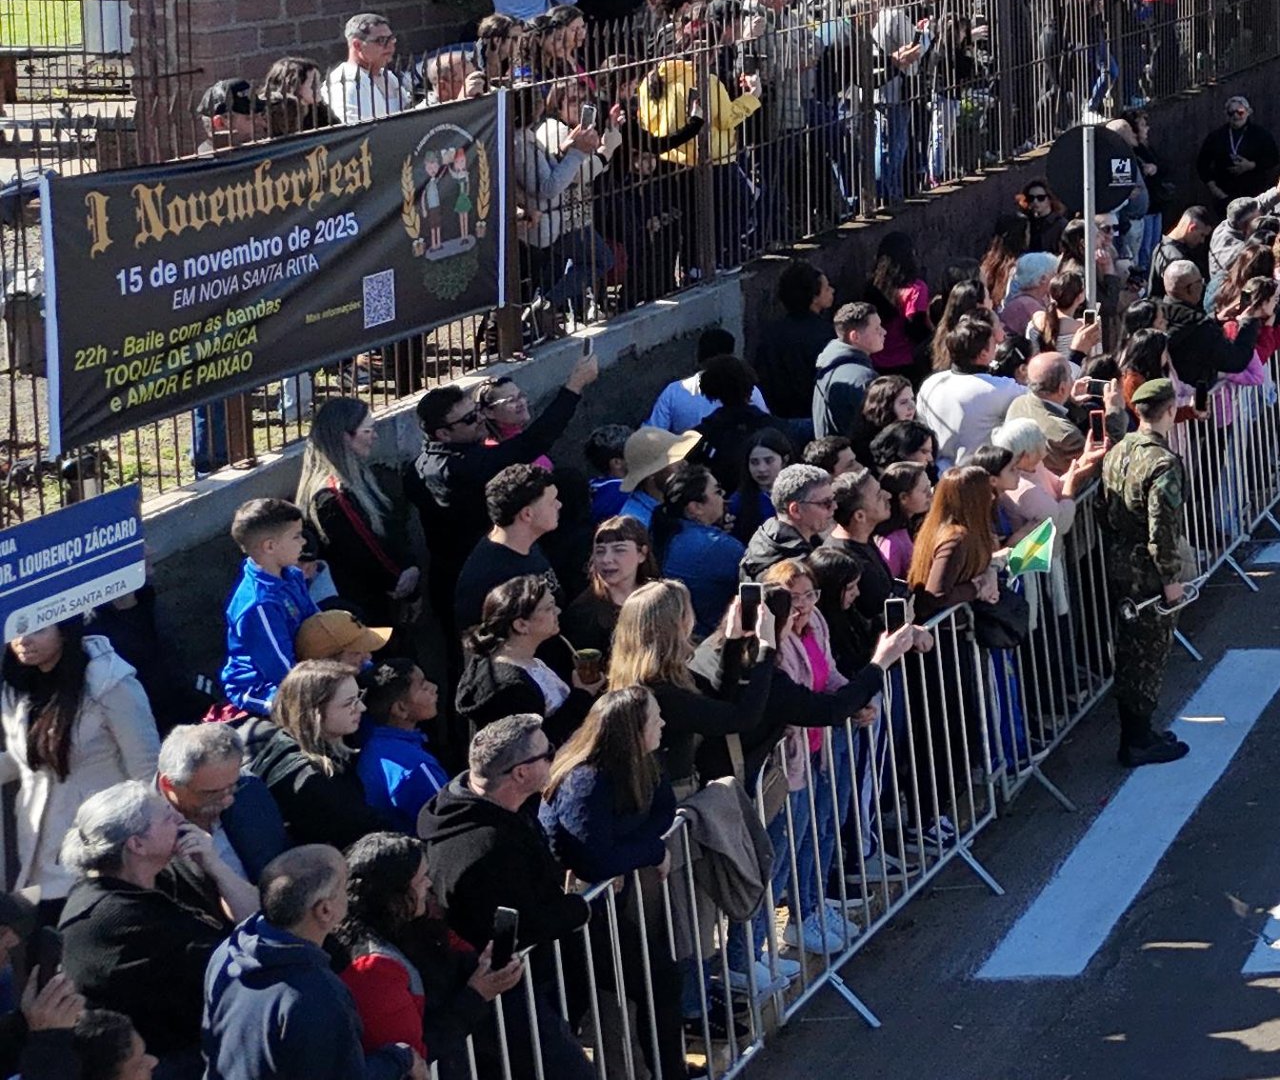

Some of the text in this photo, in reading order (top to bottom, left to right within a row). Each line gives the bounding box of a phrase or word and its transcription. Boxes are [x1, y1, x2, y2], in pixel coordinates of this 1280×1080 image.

[131, 136, 373, 249] NovemberFest
[116, 212, 359, 296] 15 de novembro de 2025
[172, 253, 319, 310] EM NOVA SANTA RITA
[74, 344, 107, 371] 22h
[123, 330, 165, 358] Baile
[169, 321, 201, 344] com
[204, 315, 222, 333] as
[226, 298, 282, 327] bandas
[104, 325, 259, 389] TOQUE DE MÁGICA
[110, 350, 253, 412] e AMOR E PAIXÃO
[0, 538, 17, 557] UA
[19, 537, 82, 578] LOURENÇO
[84, 517, 137, 554] ZÁCCARO
[36, 604, 67, 625] NOVA
[69, 590, 103, 611] SANTA
[105, 580, 127, 596] RITA
